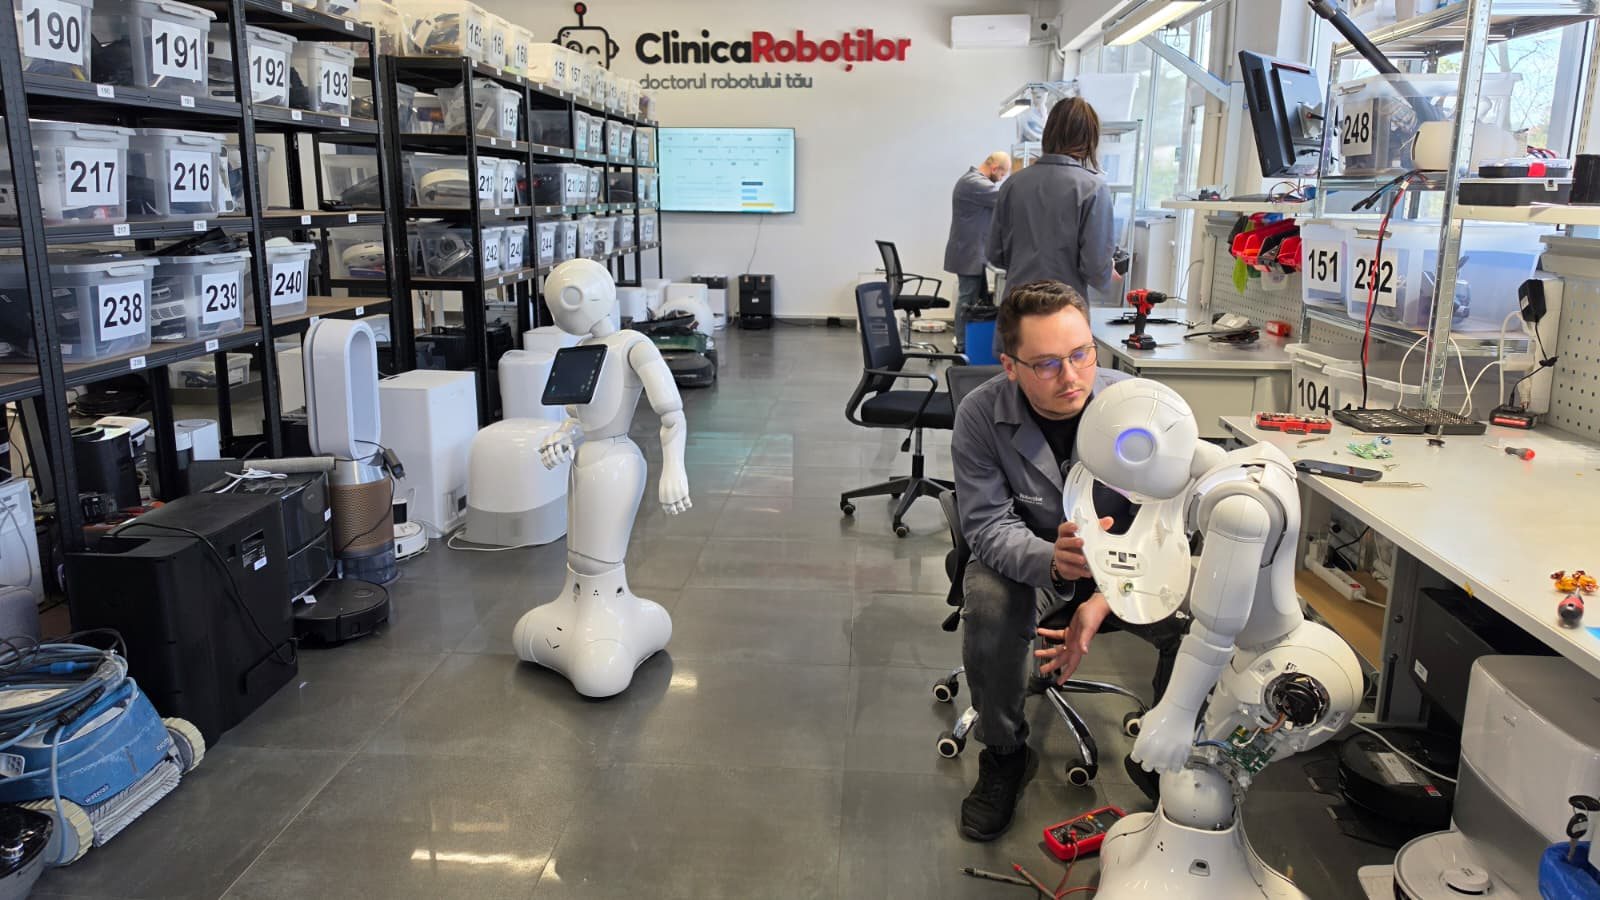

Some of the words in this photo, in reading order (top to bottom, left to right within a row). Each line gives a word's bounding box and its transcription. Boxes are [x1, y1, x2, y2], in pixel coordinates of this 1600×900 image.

[26, 8, 80, 52] 190
[155, 32, 199, 70] 191
[252, 57, 285, 88] 192
[323, 69, 348, 98] 193
[640, 73, 706, 89] doctorul
[711, 73, 781, 89] robotului
[786, 73, 812, 89] tău
[1343, 112, 1370, 144] 248
[70, 161, 116, 192] 217
[174, 162, 209, 191] 216
[486, 245, 497, 262] 242
[1308, 248, 1338, 283] 151
[274, 271, 302, 296] 240
[1355, 258, 1394, 293] 252
[104, 293, 142, 328] 238
[206, 282, 237, 312] 239
[1298, 378, 1331, 415] 104
